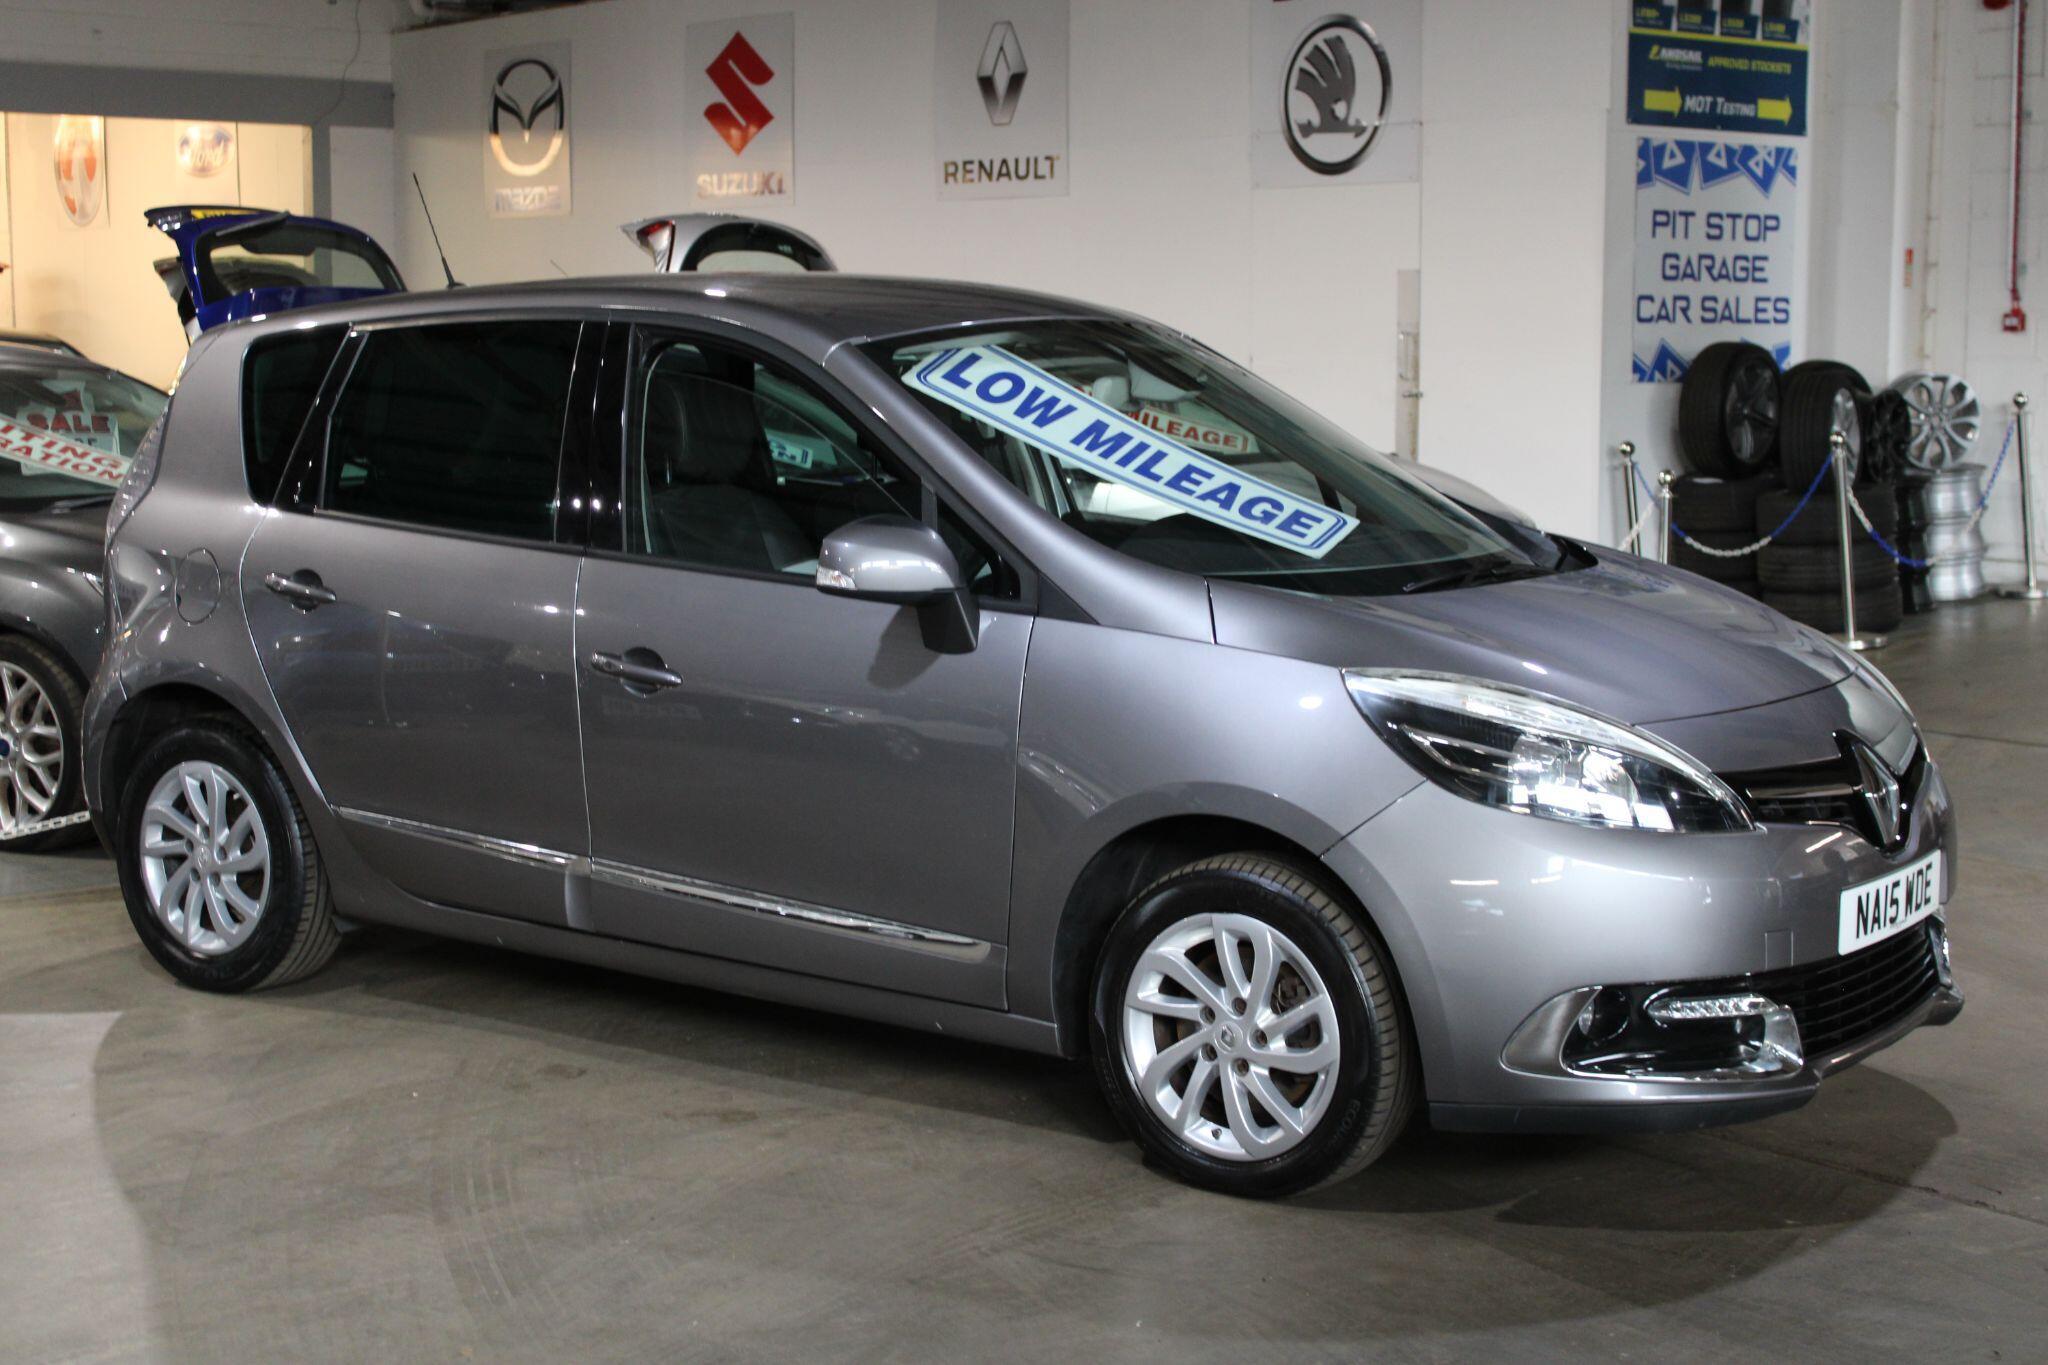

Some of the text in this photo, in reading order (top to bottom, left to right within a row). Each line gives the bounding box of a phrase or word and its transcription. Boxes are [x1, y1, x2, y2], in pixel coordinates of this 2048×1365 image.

[1684, 95, 1713, 115] MOT
[697, 171, 786, 198] SUZUKI
[944, 155, 1060, 184] RENAULT
[1652, 210, 1780, 242] PIT STOP
[1661, 252, 1769, 283] GARAGE
[1636, 294, 1790, 324] CAR SALES
[941, 352, 1324, 540] LOW MILEAGE
